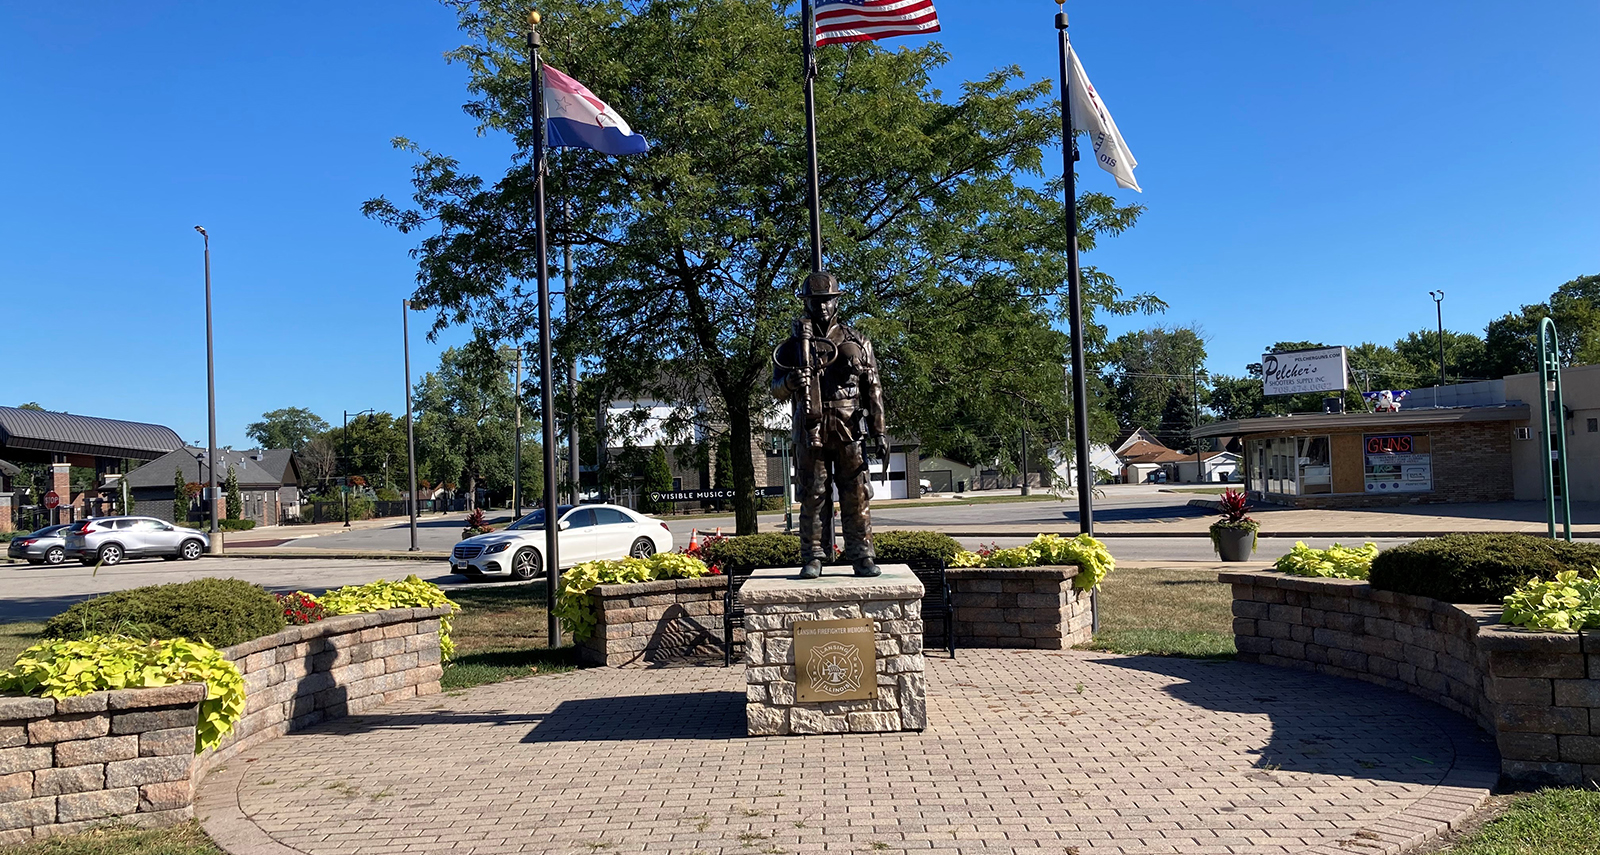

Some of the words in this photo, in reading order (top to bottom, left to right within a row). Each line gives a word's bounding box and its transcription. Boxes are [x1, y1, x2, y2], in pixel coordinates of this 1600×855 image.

[1294, 353, 1341, 362] PELCHERGUNS.COM
[1264, 355, 1317, 384] Pelcher's
[1368, 436, 1410, 452] GUNS
[696, 490, 724, 498] MUSIC
[817, 627, 847, 635] FIREFIGHTER
[820, 645, 850, 654] LANSING
[823, 683, 850, 692] ILLINOIS
